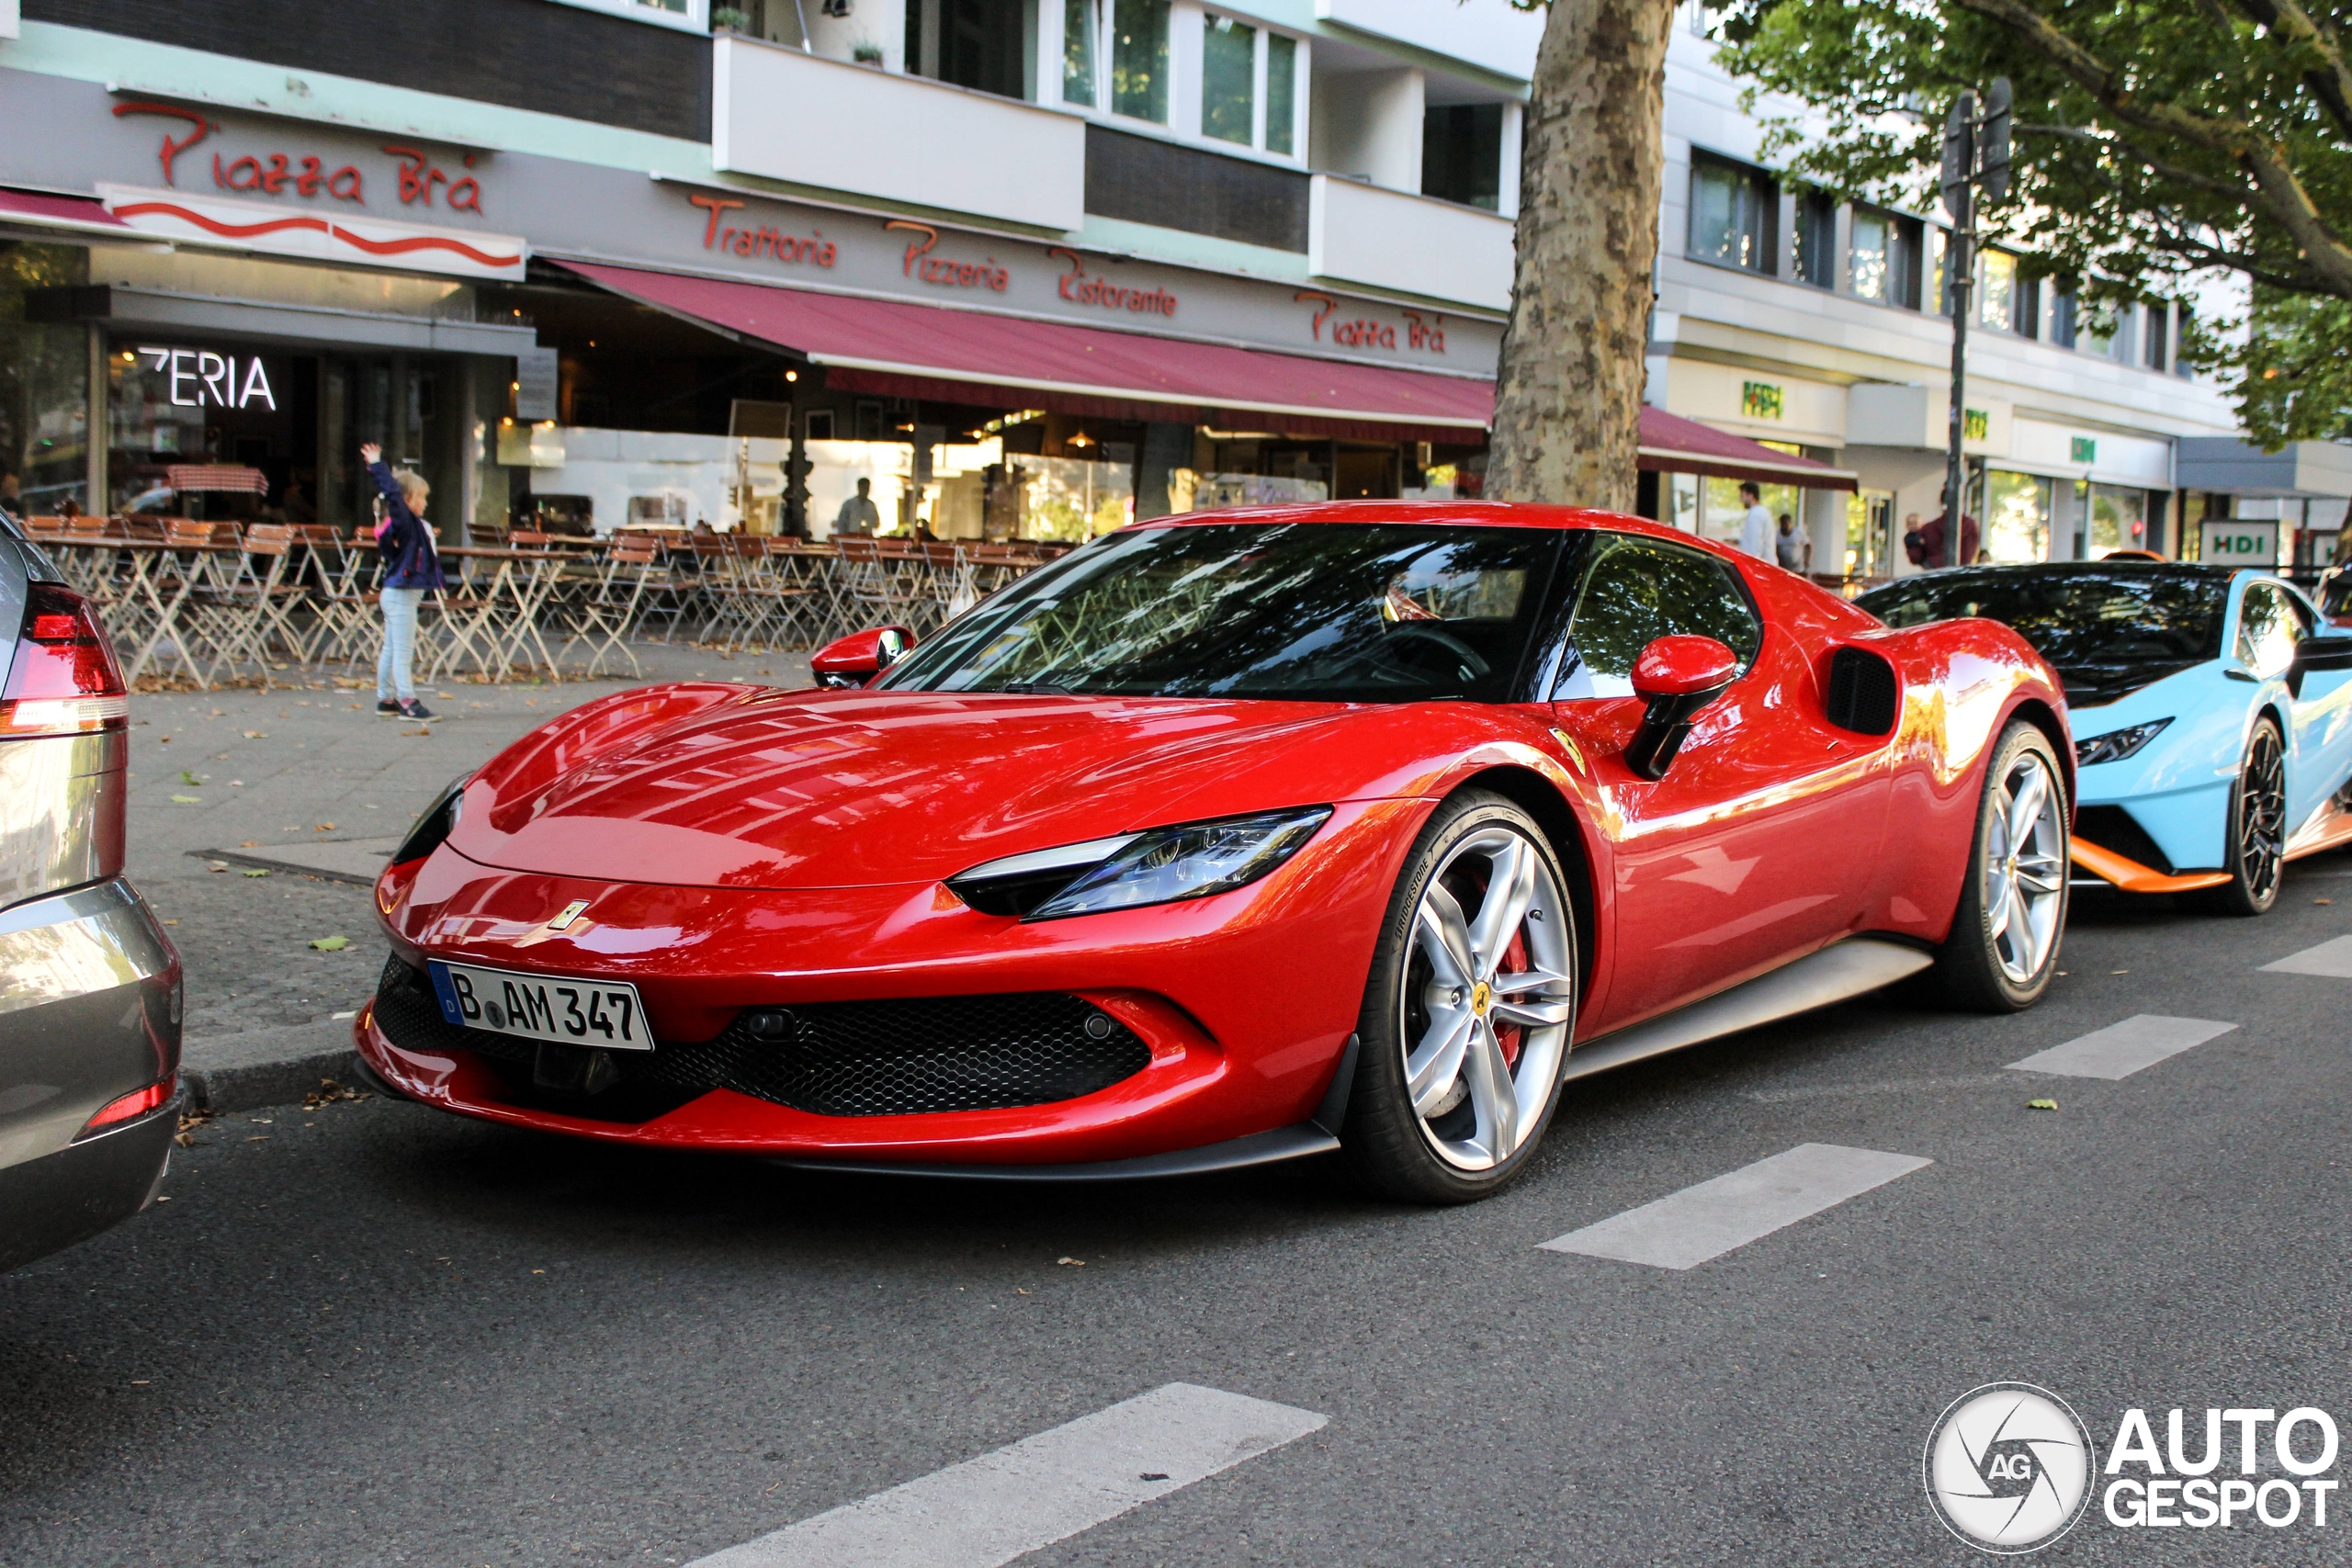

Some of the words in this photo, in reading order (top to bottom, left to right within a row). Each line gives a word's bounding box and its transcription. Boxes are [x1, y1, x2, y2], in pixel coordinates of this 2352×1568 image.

[111, 102, 366, 207] Piazza
[690, 195, 837, 267] Trattoria
[884, 220, 1009, 292] Pizzeria
[1048, 247, 1178, 317] Ristorante
[1295, 292, 1396, 349] Piazza
[1743, 381, 1784, 420] HDI
[2214, 535, 2264, 554] HDI
[1395, 858, 1430, 942] BRIDGESTONE
[451, 972, 481, 1021] B
[503, 980, 557, 1033] AM
[556, 987, 633, 1042] 347
